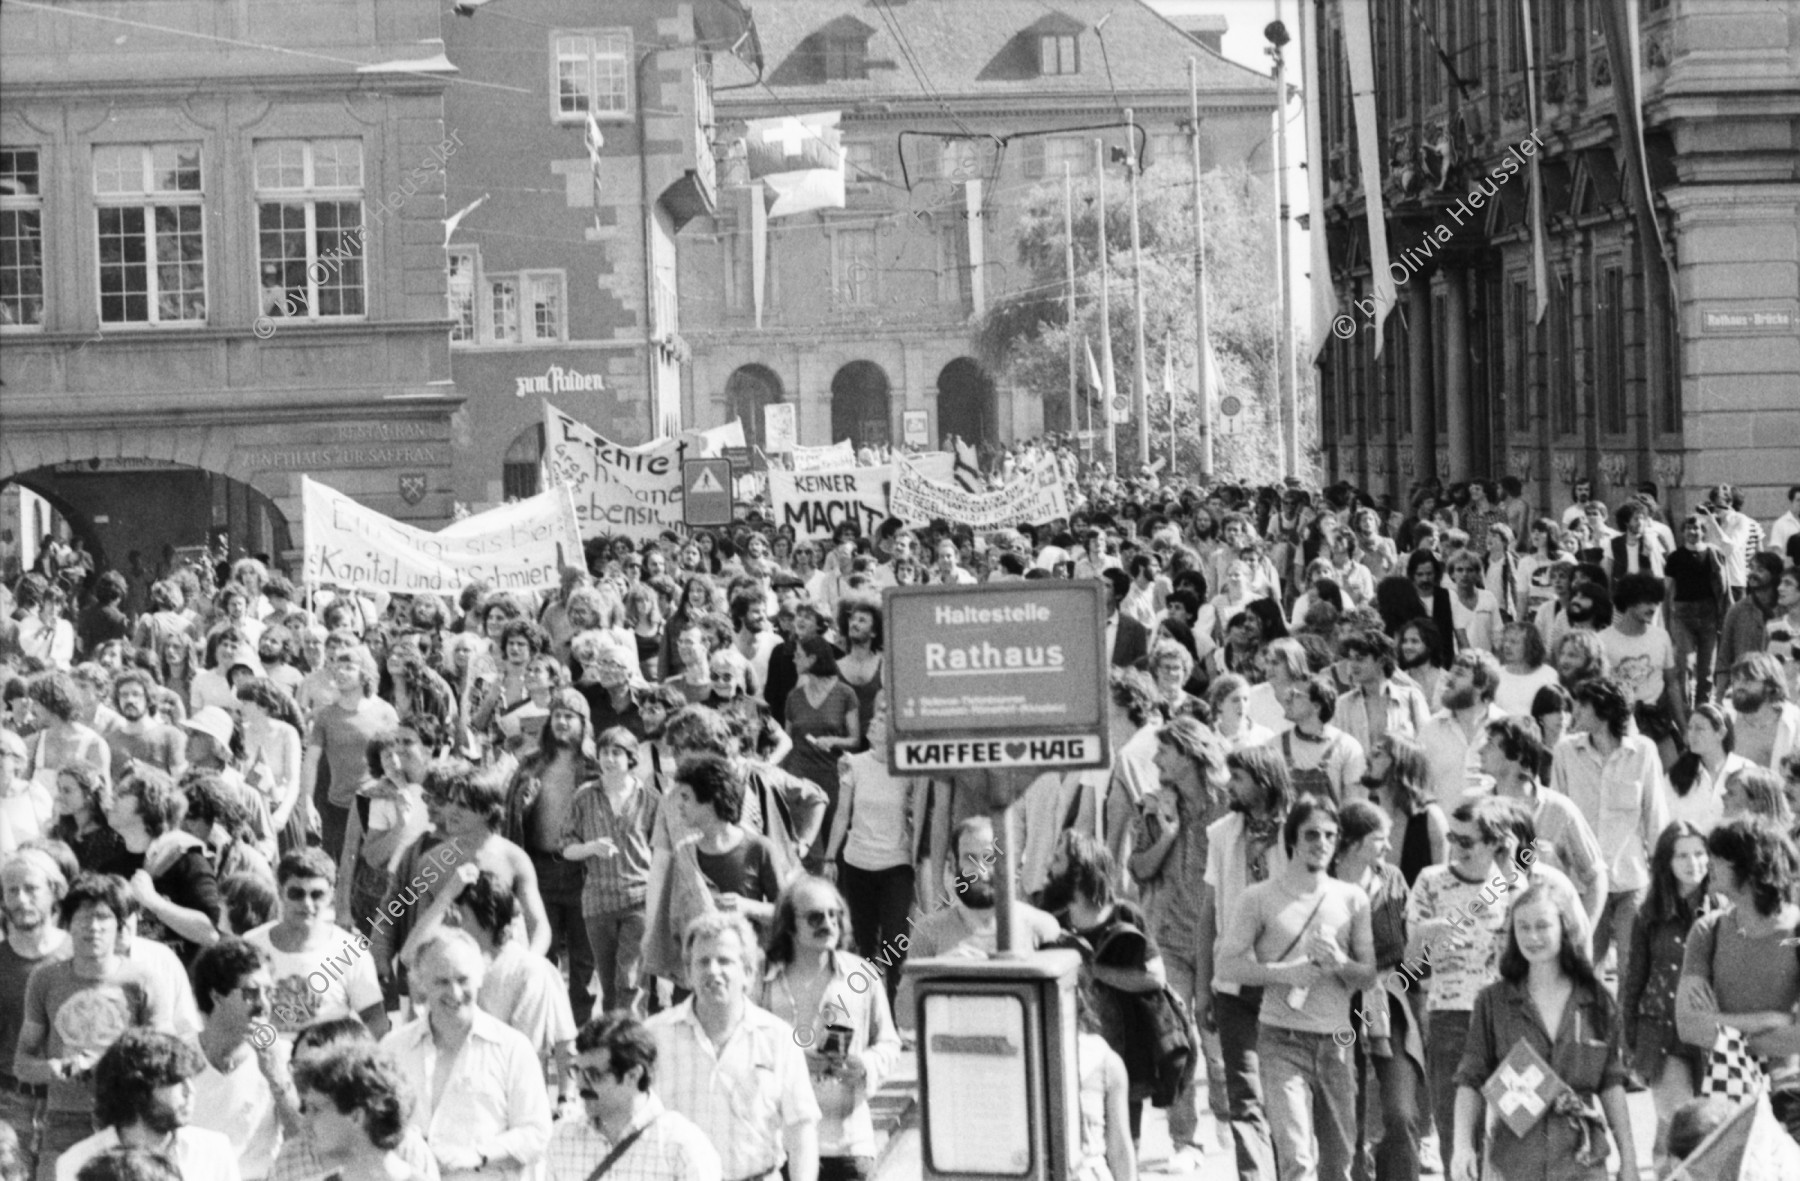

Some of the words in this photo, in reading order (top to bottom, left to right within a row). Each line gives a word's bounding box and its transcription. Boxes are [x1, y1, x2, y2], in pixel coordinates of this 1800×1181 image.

[515, 376, 551, 397] zum
[368, 447, 436, 463] SAFFRAN
[594, 457, 683, 505] hane
[794, 474, 857, 493] KEINER
[784, 500, 884, 536] MACHT
[406, 566, 441, 590] und
[935, 603, 1050, 624] Haltestelle
[925, 640, 1065, 671] Rathaus
[906, 742, 1002, 764] KAFFEE
[1030, 739, 1084, 760] HAG
